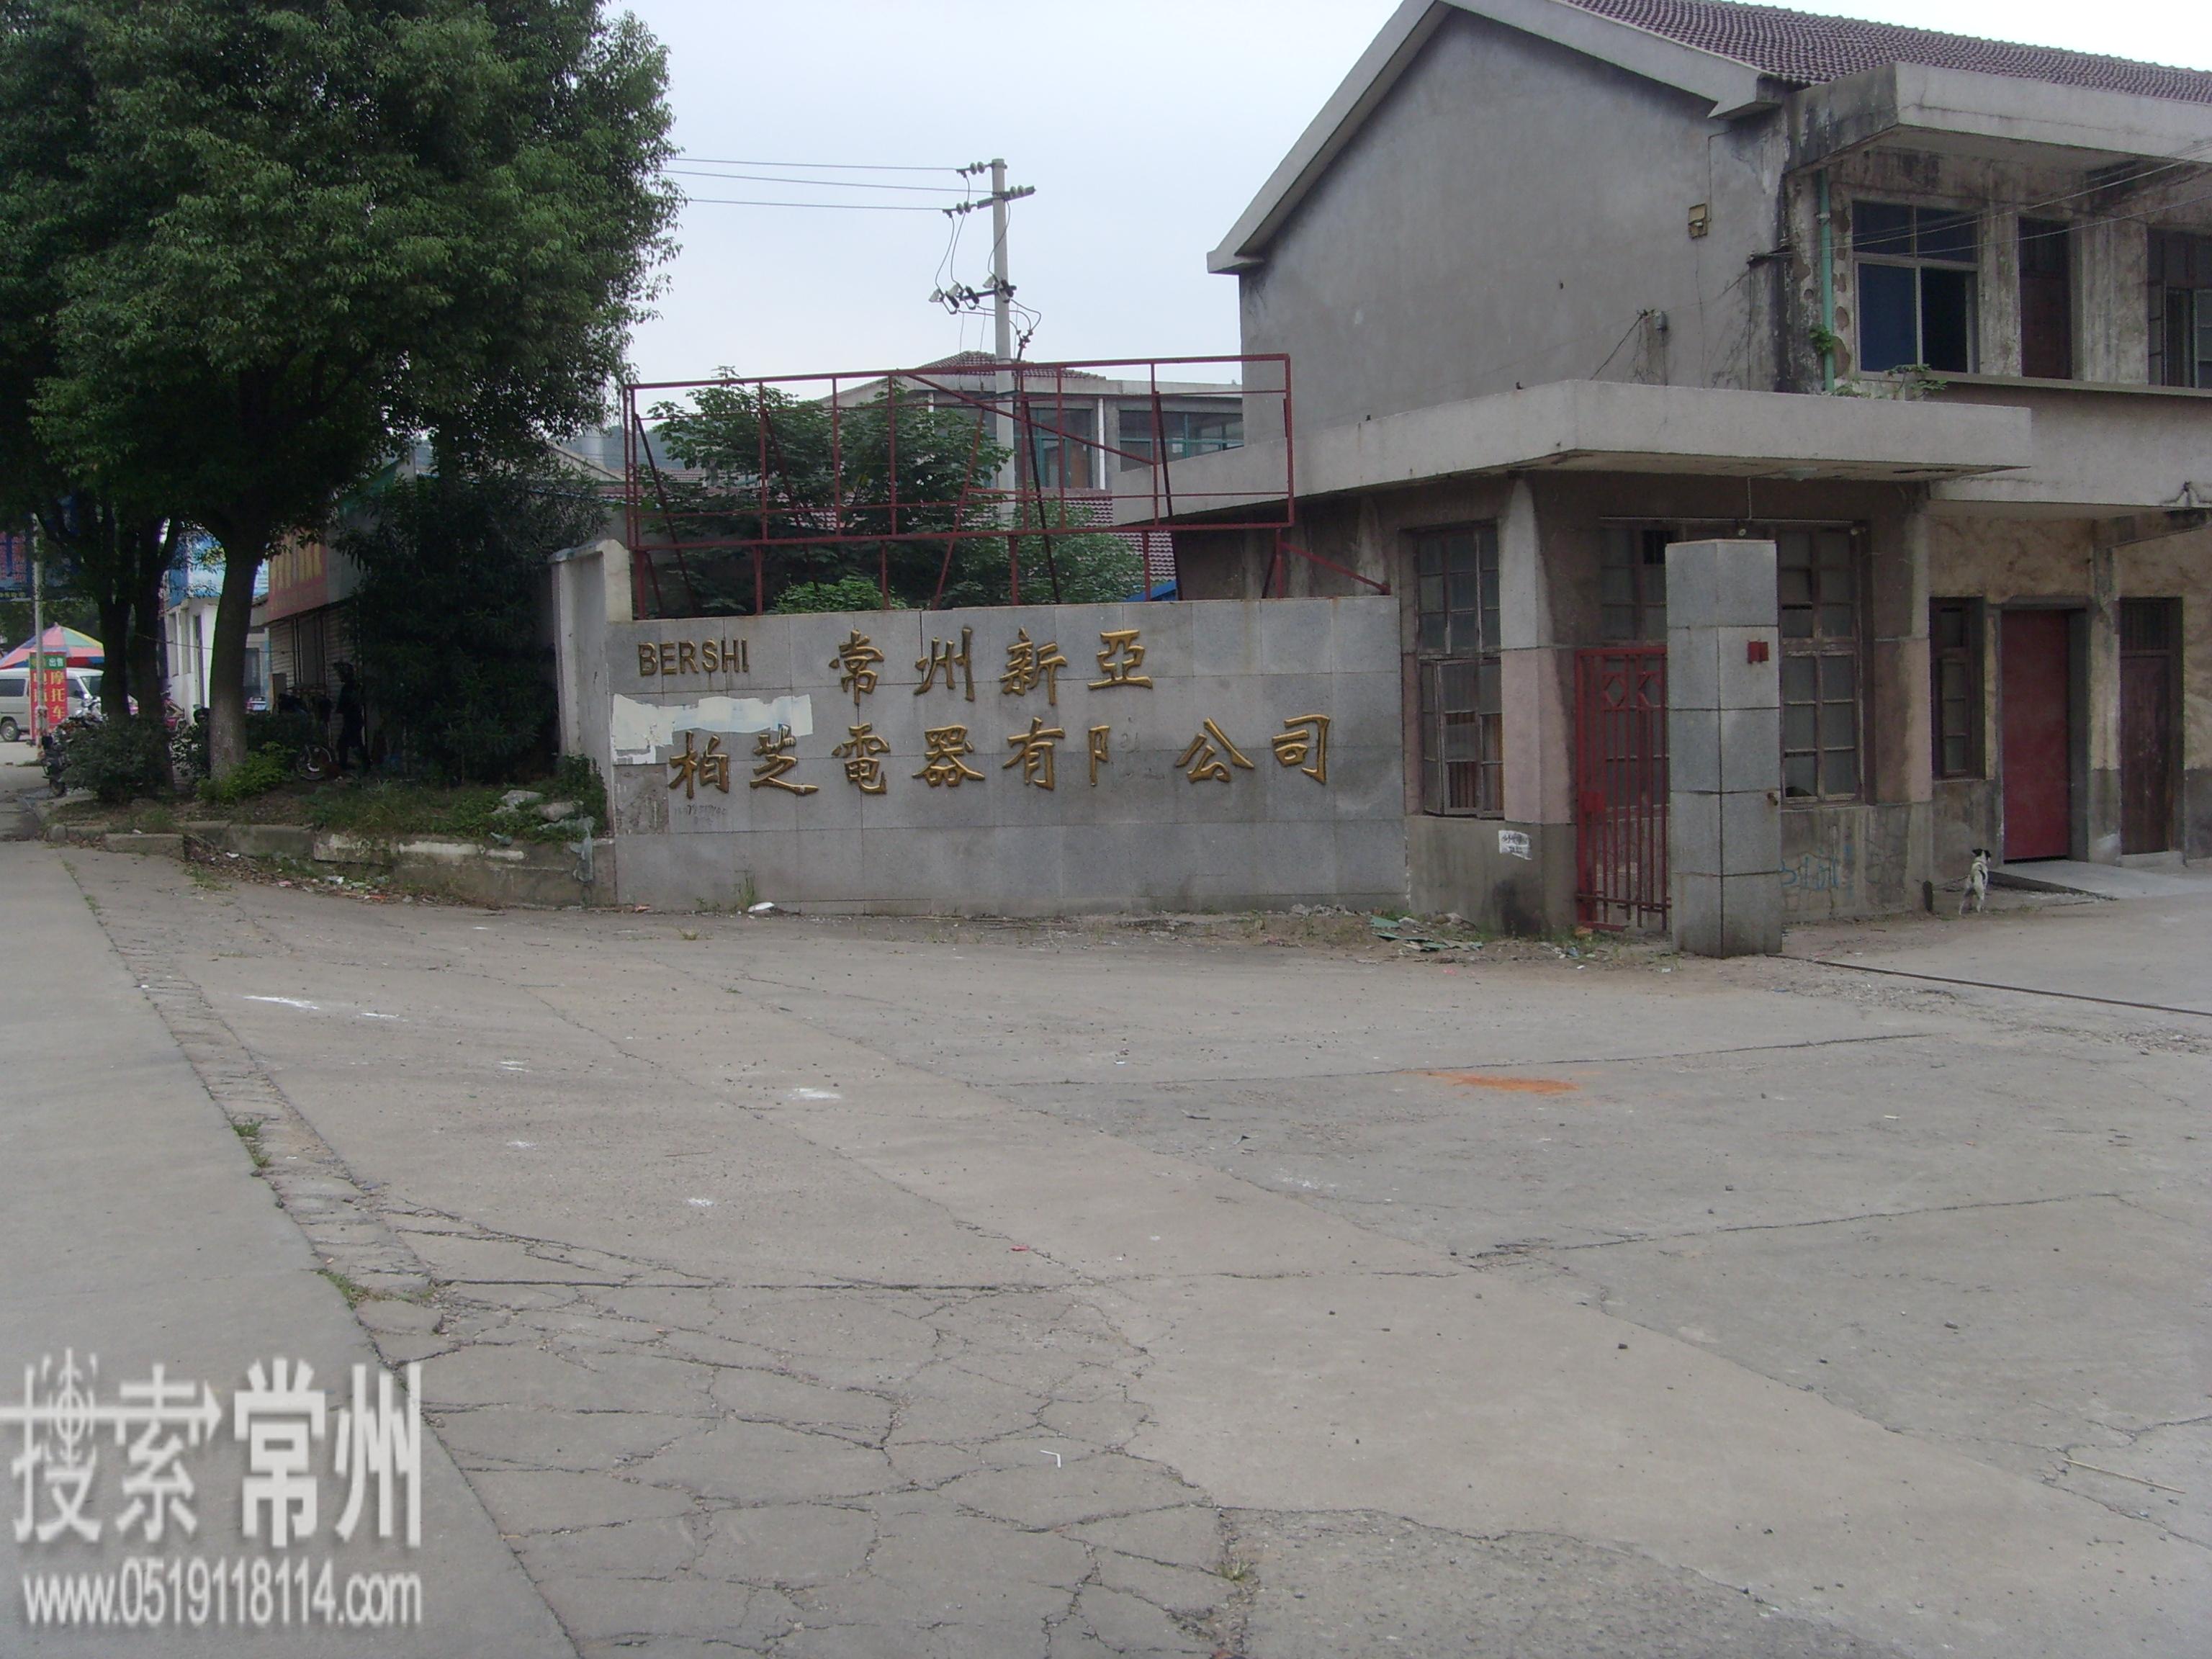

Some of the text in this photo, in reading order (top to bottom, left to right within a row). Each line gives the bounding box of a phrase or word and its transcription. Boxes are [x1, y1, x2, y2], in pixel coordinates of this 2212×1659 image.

[638, 638, 750, 676] BERSHI
[829, 626, 1153, 706] 常州新亞
